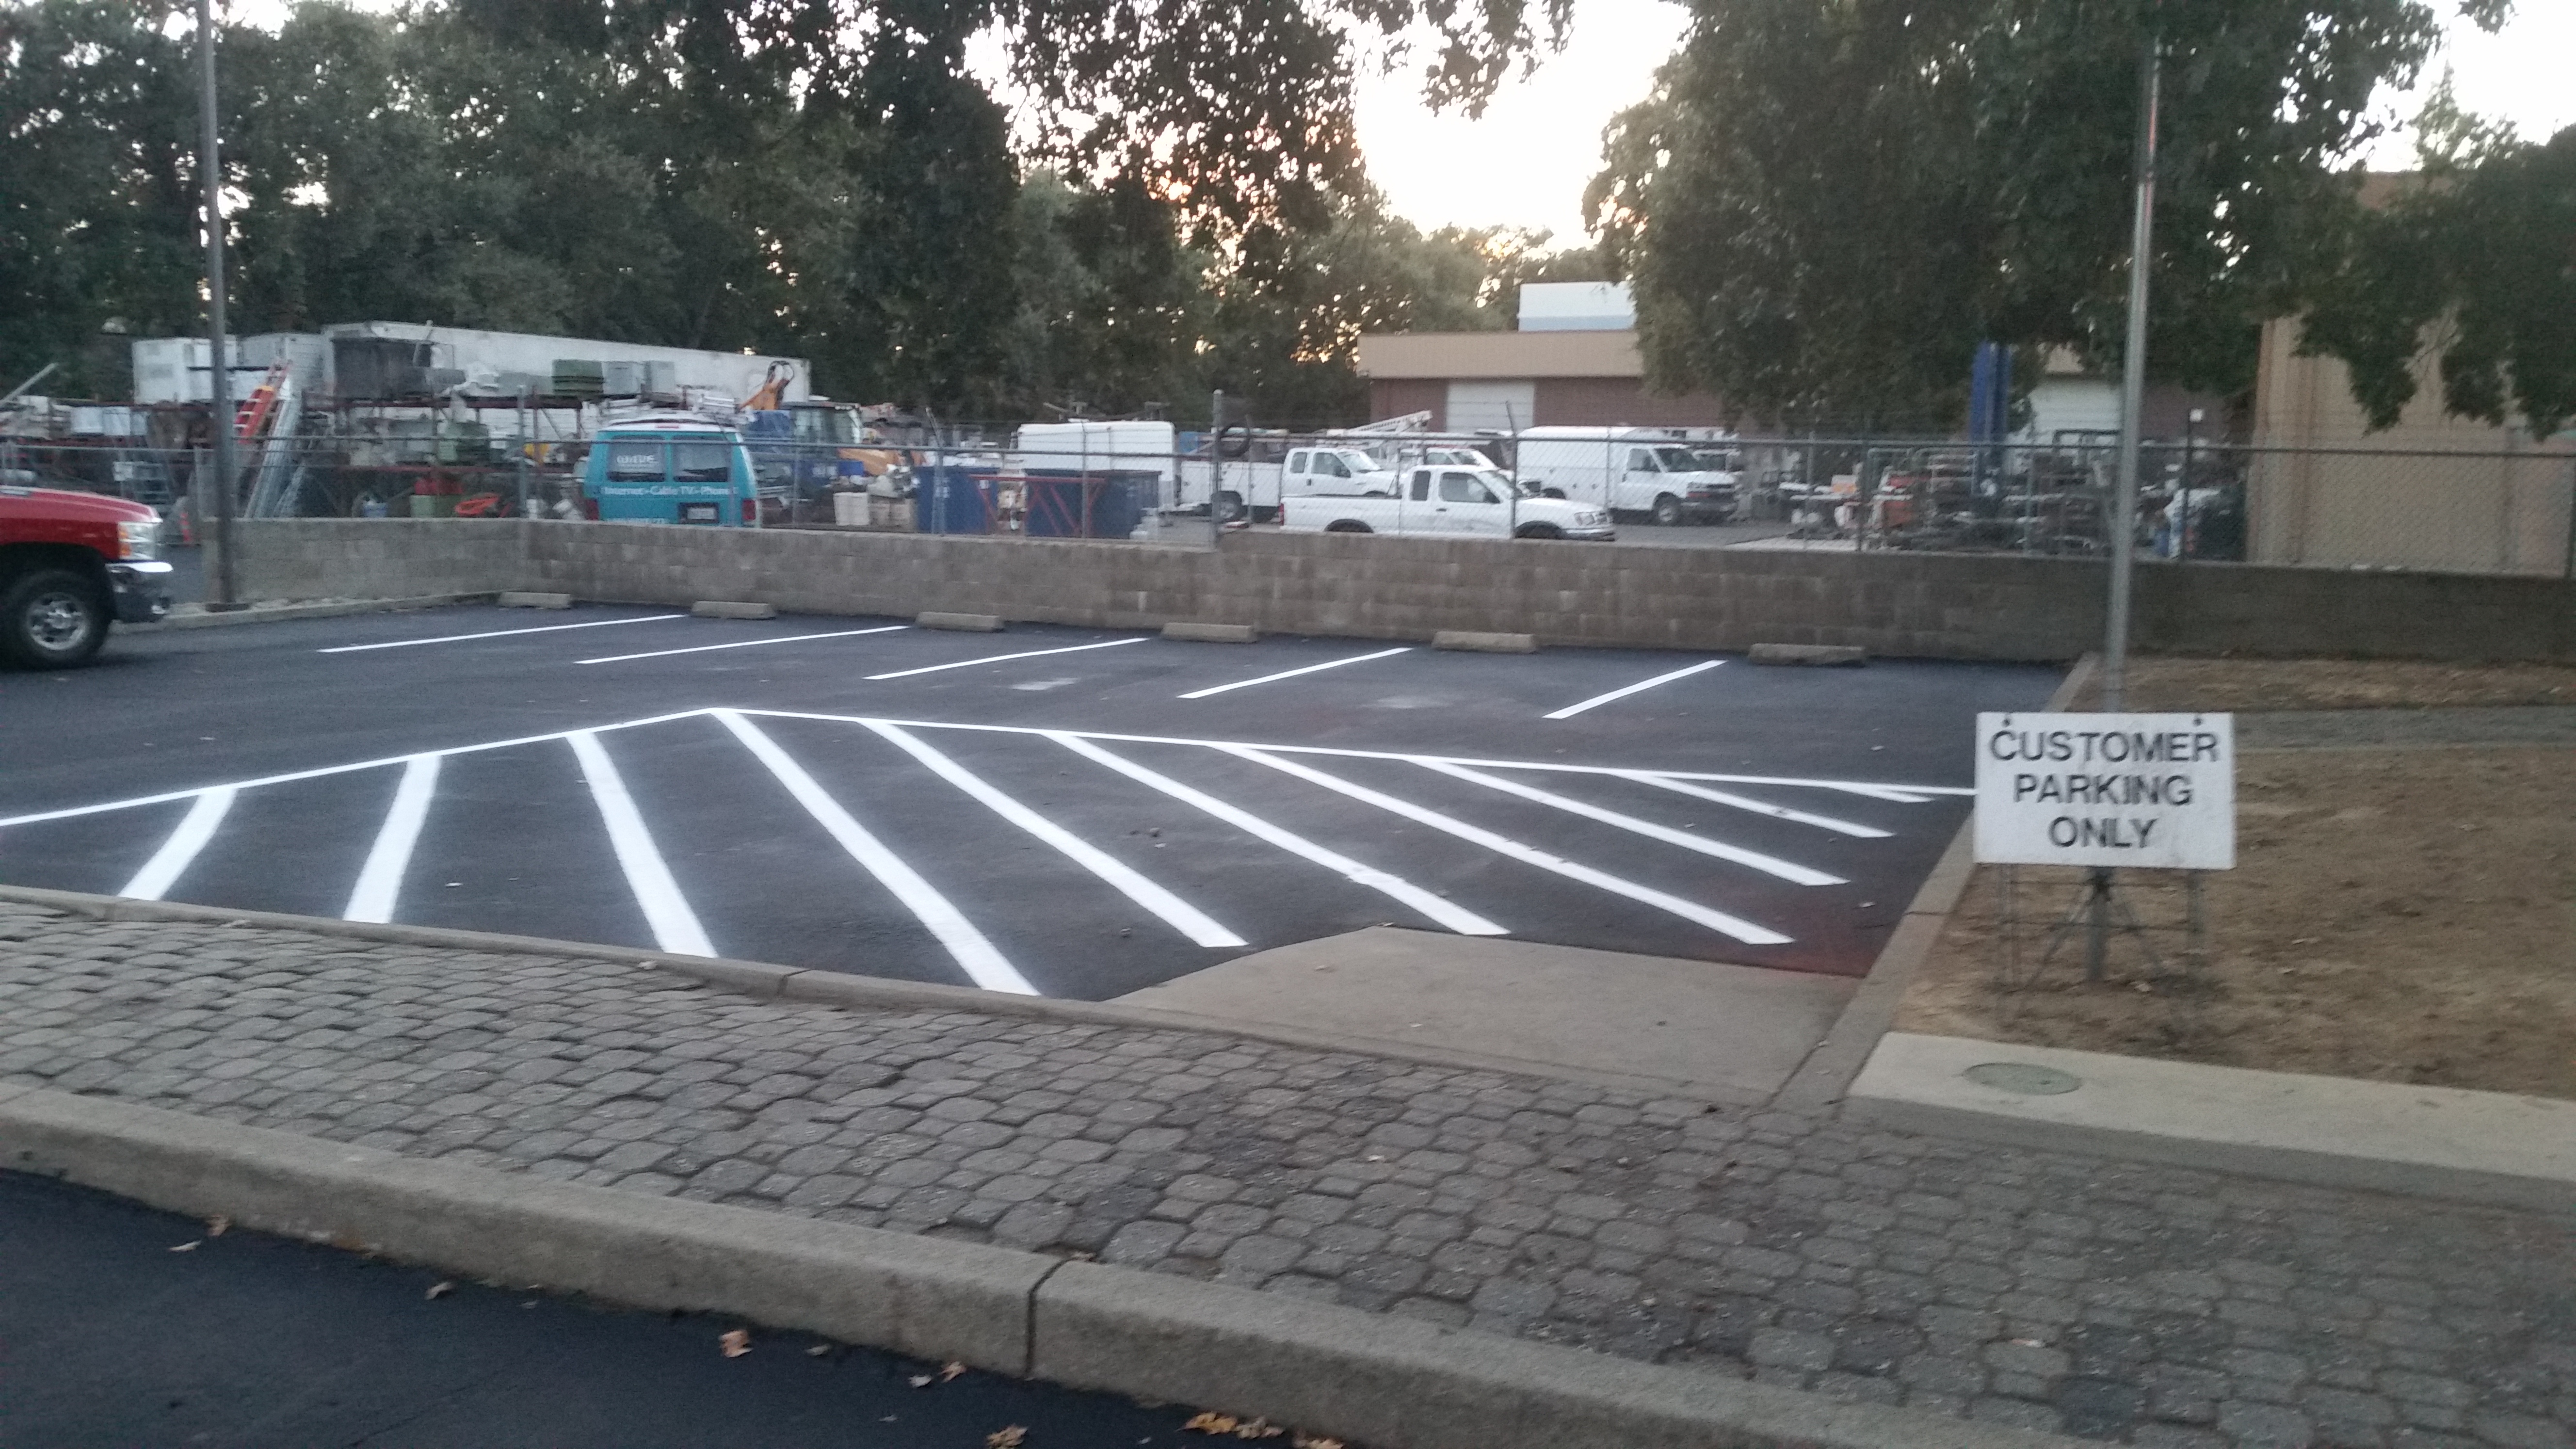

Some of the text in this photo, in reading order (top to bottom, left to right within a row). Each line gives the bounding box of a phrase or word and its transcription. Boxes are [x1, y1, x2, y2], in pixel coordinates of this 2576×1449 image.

[1990, 730, 2220, 762] CUSTOMER
[2013, 774, 2194, 805] PARKING
[2047, 816, 2159, 848] ONLY
